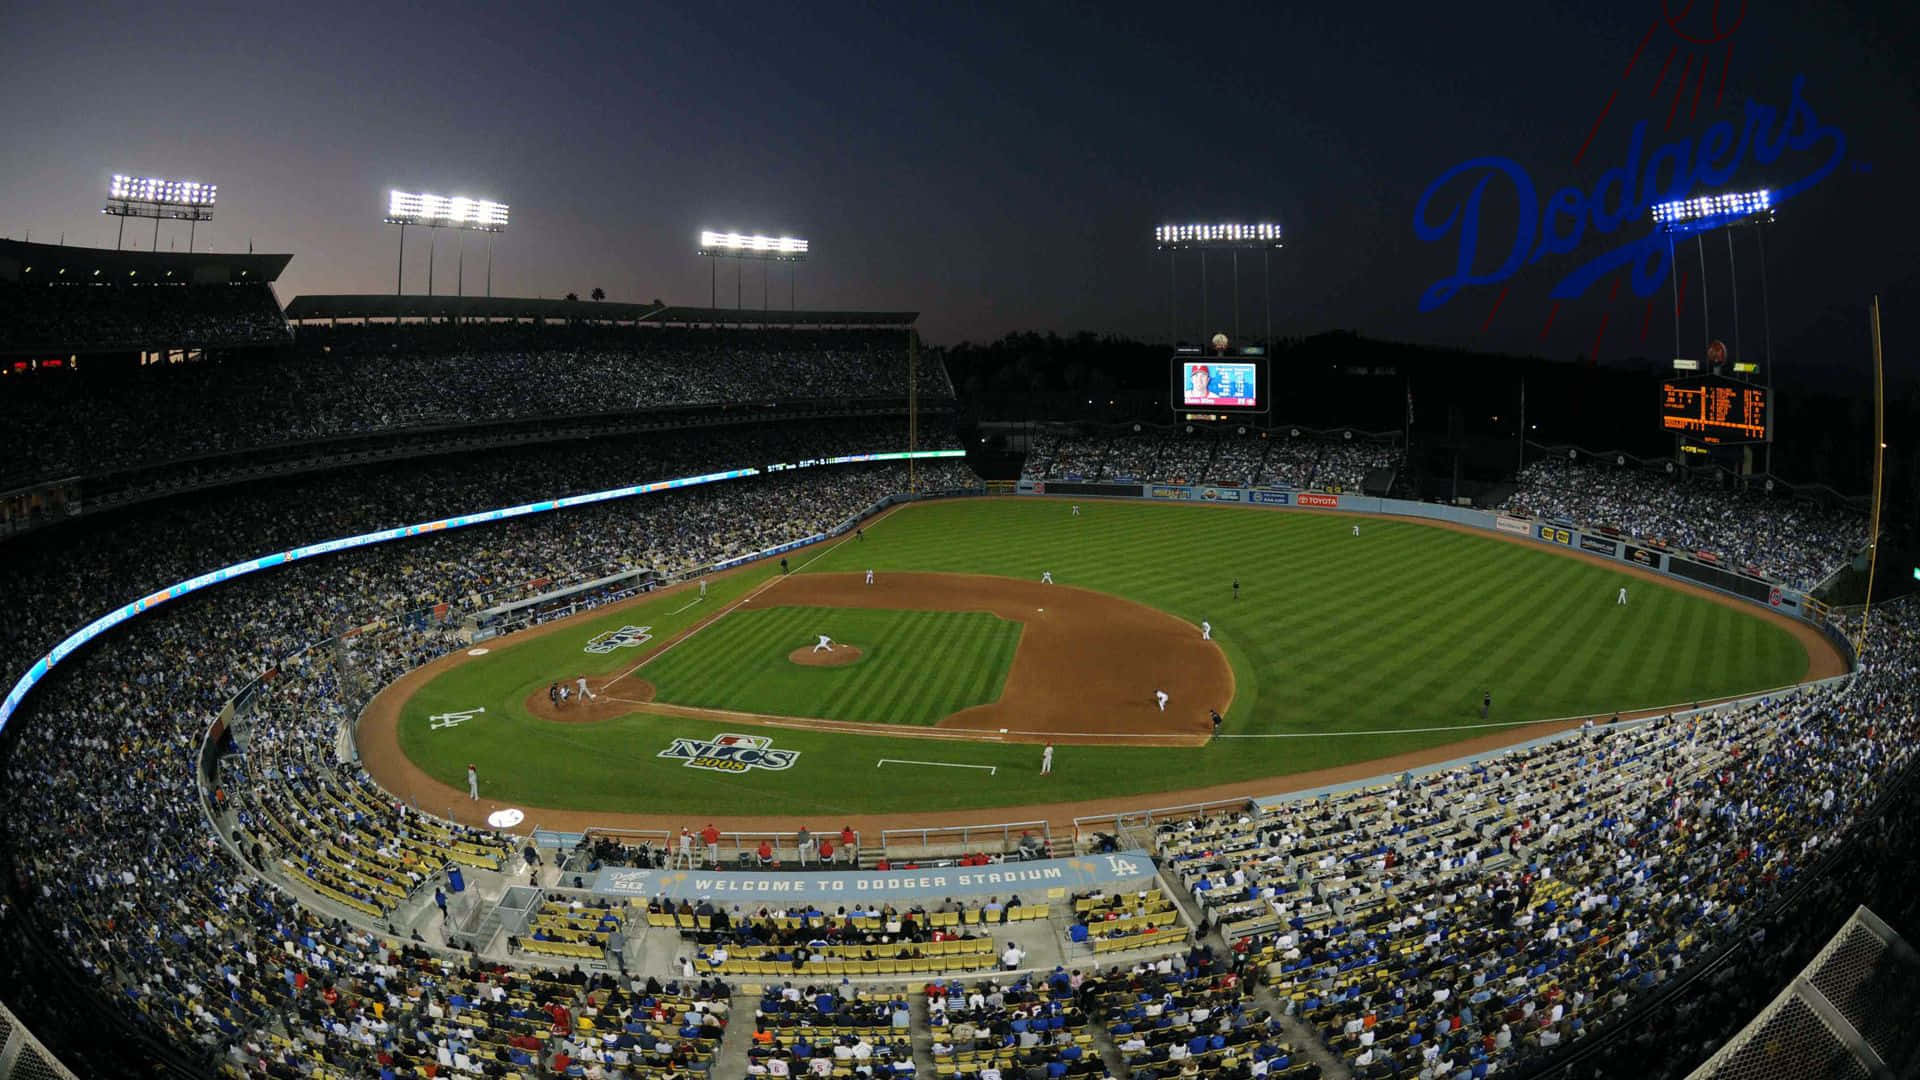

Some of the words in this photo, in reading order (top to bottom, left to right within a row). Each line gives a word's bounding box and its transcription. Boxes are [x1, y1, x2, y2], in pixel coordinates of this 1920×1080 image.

[1309, 496, 1336, 505] TOYOTA
[659, 739, 798, 769] NLCS
[692, 757, 747, 771] 2008
[1105, 854, 1140, 877] LA
[695, 879, 806, 892] WELCOME
[817, 879, 845, 891] TO
[857, 876, 947, 891] DODGER
[959, 866, 1063, 887] STADIUM
